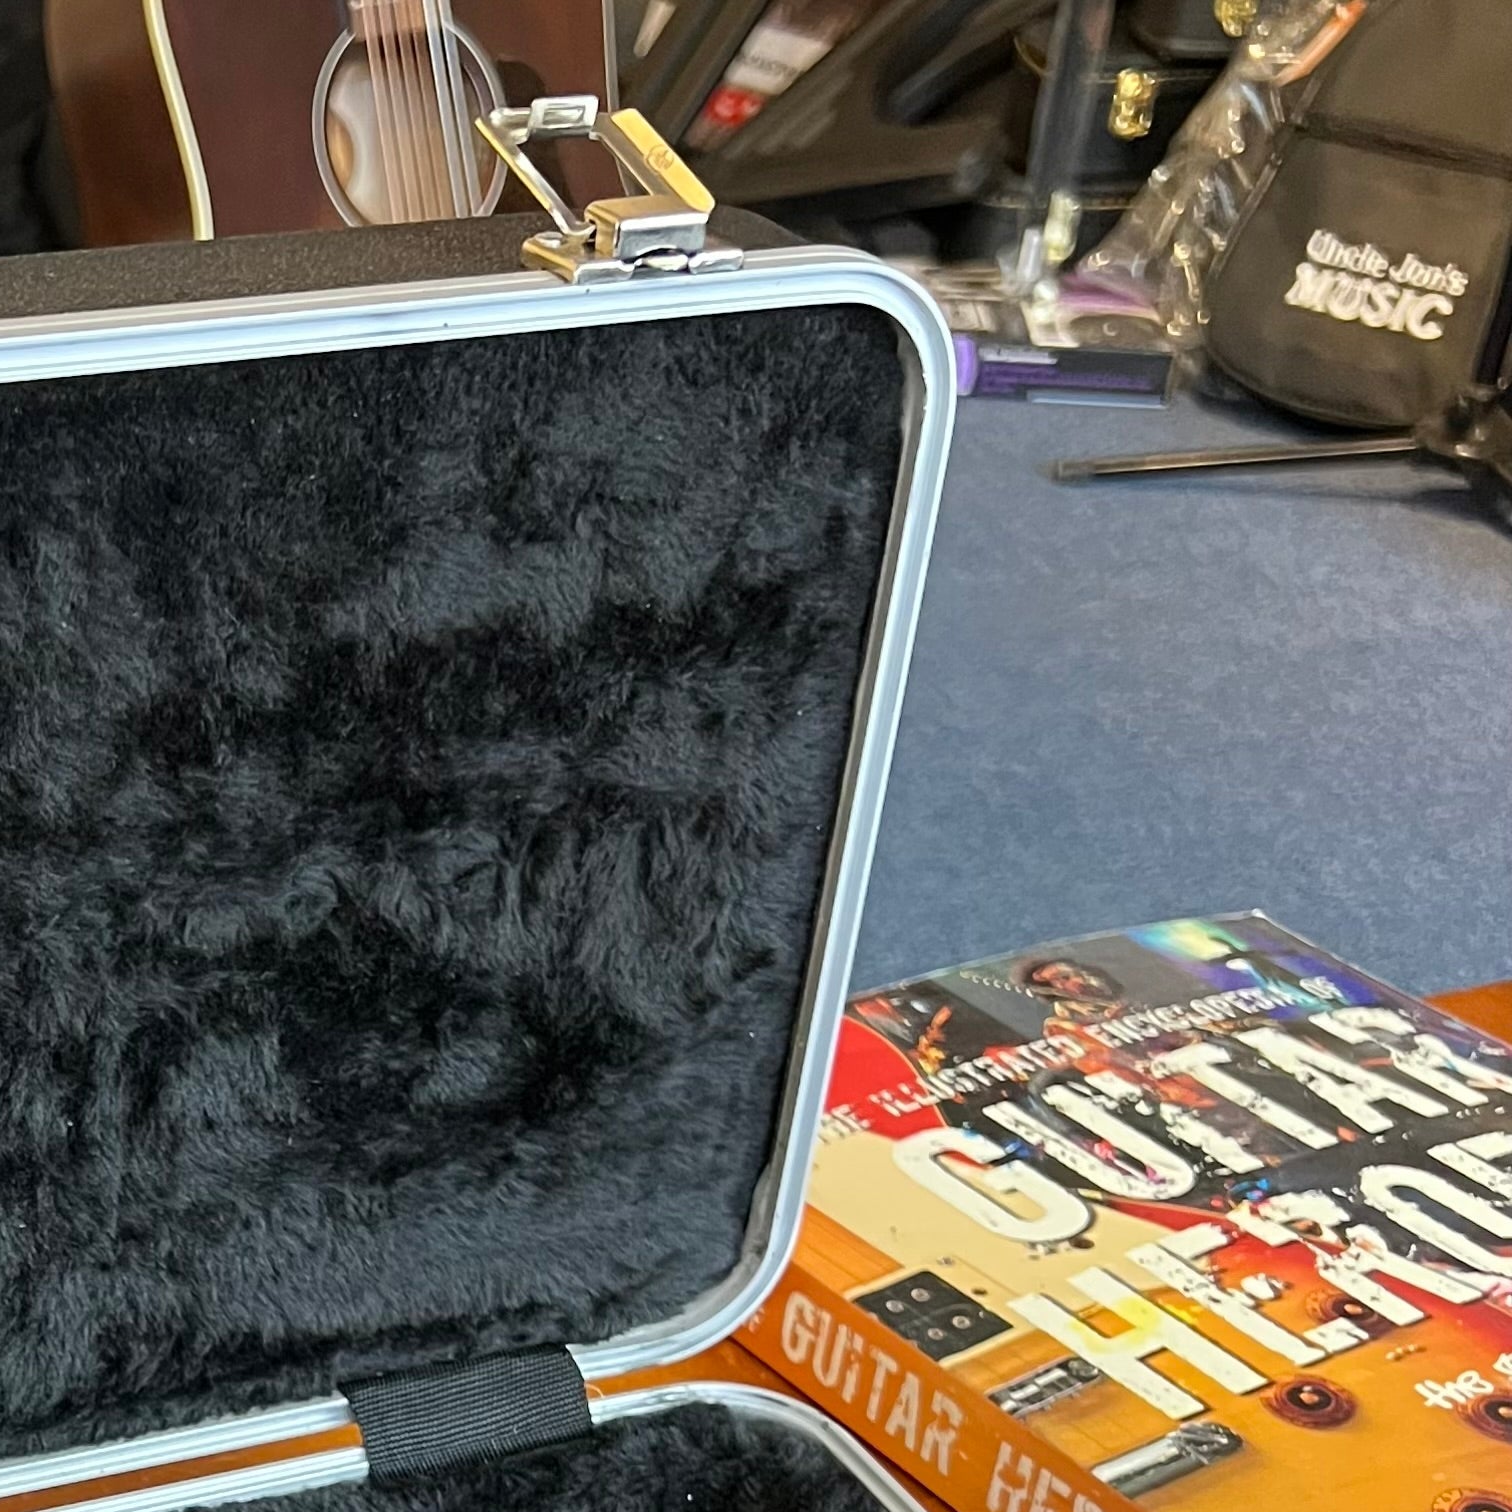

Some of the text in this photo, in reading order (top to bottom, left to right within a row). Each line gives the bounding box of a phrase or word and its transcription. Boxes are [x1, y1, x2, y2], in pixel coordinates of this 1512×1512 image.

[1284, 262, 1453, 340] MUSIC
[868, 1034, 1086, 1118] ILLUSTRATED
[1299, 976, 1344, 1001] OF
[891, 1006, 1512, 1242] GUITAR
[781, 1291, 964, 1477] GUITAR
